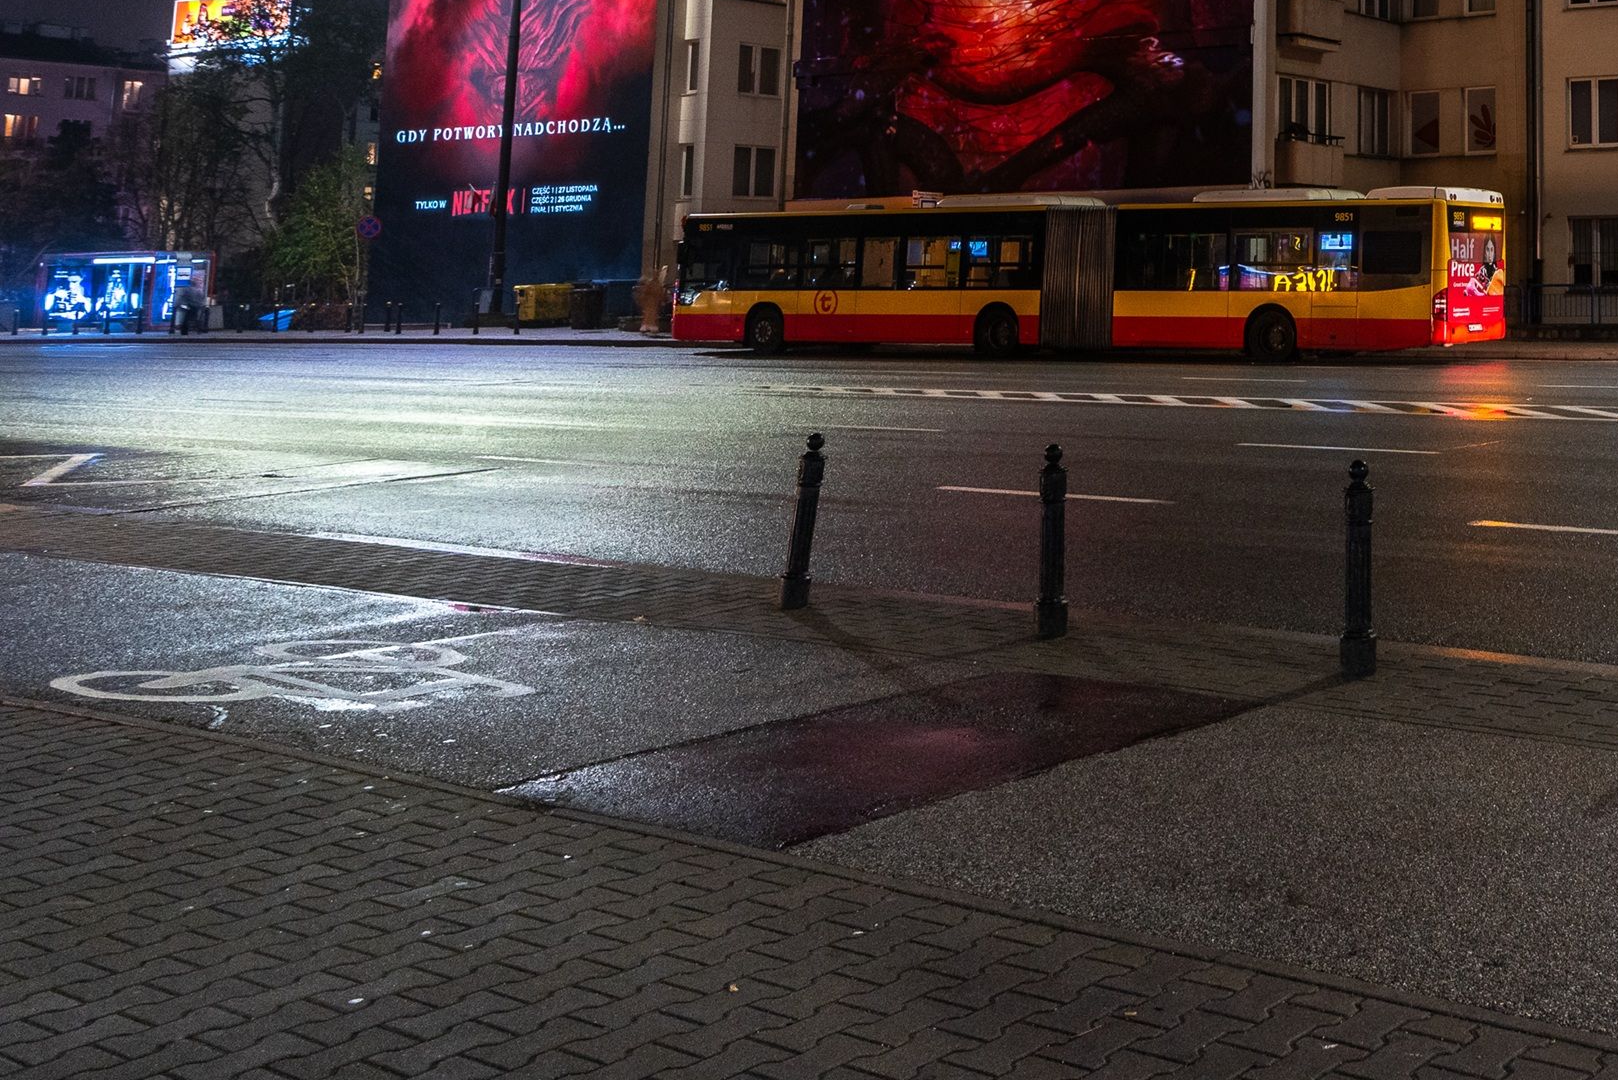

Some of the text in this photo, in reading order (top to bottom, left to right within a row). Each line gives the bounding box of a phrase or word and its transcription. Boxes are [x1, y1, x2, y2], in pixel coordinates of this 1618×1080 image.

[396, 117, 626, 143] GDY POTWORY NADCHODZĄ...
[531, 186, 550, 196] CZĘŚĆ
[566, 184, 598, 193] LISTOPADA
[415, 200, 447, 210] TYLKO W
[531, 195, 550, 205] CZĘŚĆ
[565, 194, 592, 203] GRUDNIA
[530, 205, 547, 213] FINAŁ
[555, 204, 583, 212] STYCZNIA
[1334, 212, 1354, 221] 9851
[1451, 238, 1475, 260] Half
[1451, 261, 1475, 278] Price
